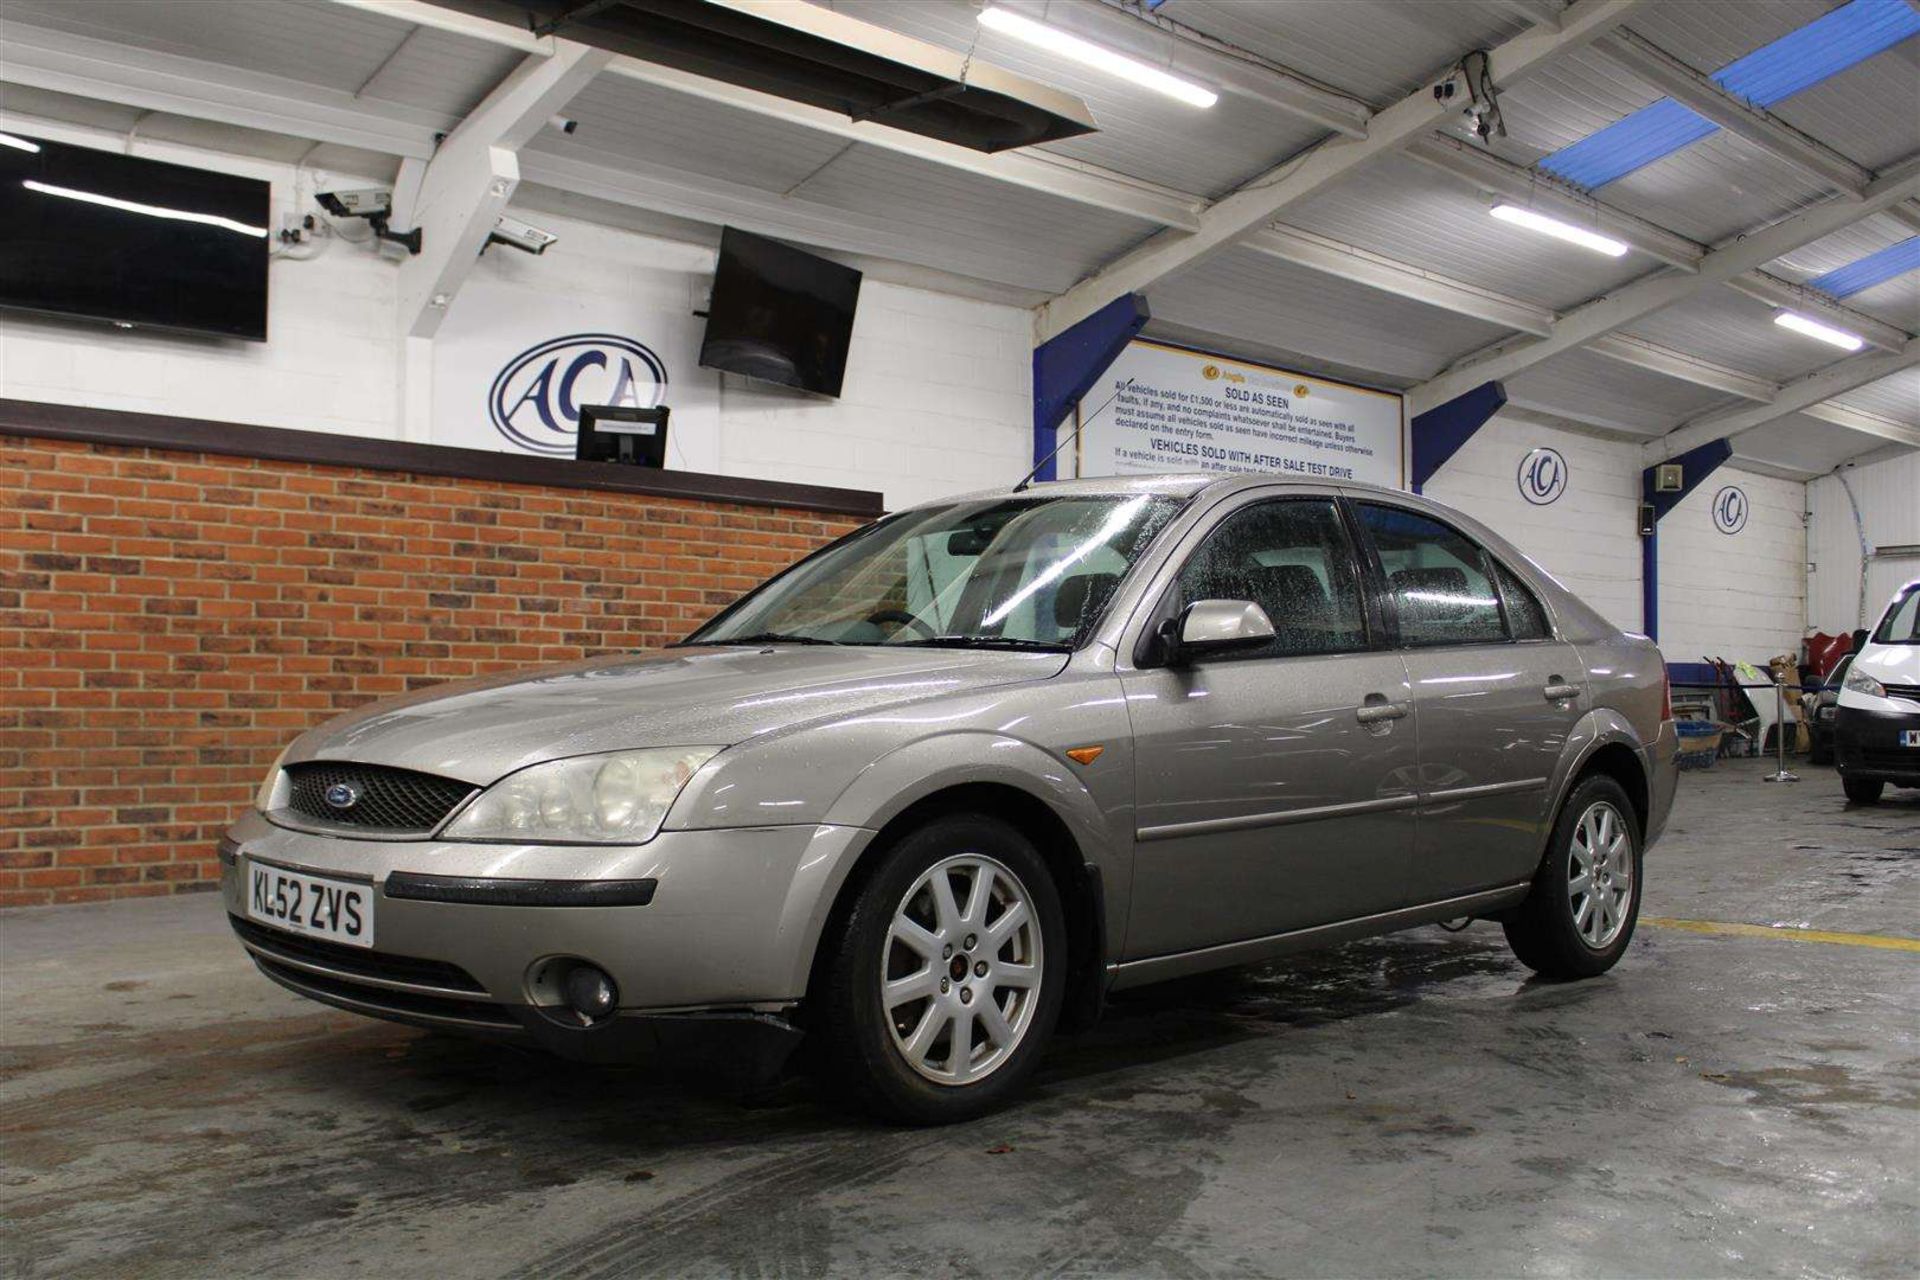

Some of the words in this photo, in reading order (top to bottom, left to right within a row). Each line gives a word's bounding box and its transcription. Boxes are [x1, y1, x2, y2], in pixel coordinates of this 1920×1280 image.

[1115, 381, 1126, 389] All
[1127, 384, 1158, 396] vehicles
[1161, 390, 1176, 399] sold
[1178, 392, 1188, 401] for
[1223, 401, 1237, 411] less
[1251, 408, 1293, 422] automatically
[1295, 415, 1308, 424] sold
[1319, 420, 1332, 428] seen
[1334, 423, 1346, 431] with
[1225, 387, 1249, 401] SOLD
[1252, 393, 1264, 404] AS
[1266, 395, 1289, 409] SEEN
[1115, 417, 1148, 430] declared
[1150, 423, 1159, 431] on
[1161, 424, 1173, 434] the
[1175, 426, 1194, 439] entry
[1115, 406, 1135, 416] must
[1136, 409, 1165, 421] assume
[1167, 414, 1176, 422] all
[1178, 416, 1207, 428] vehicles
[1209, 421, 1224, 431] sold
[1235, 426, 1251, 435] seen
[1252, 428, 1268, 438] have
[1269, 430, 1298, 442] incorrect
[1299, 437, 1323, 449] mileage
[1324, 441, 1343, 451] unless
[1150, 400, 1165, 411] any,
[1167, 403, 1180, 412] and
[1182, 406, 1191, 414] no
[1193, 408, 1231, 420] complaints
[1233, 415, 1270, 427] whatsoever
[1271, 421, 1287, 430] shall
[1288, 424, 1296, 432] be
[1335, 431, 1355, 443] Buyers
[1129, 451, 1156, 461] vehicle
[1158, 454, 1164, 462] is
[1166, 455, 1182, 464] sold
[1201, 461, 1209, 469] an
[1211, 462, 1227, 471] after
[1228, 464, 1242, 472] sale
[1150, 438, 1199, 456] VEHICLES
[1201, 445, 1226, 460] SOLD
[1228, 449, 1251, 464] WITH
[1253, 454, 1281, 468] AFTER
[1283, 458, 1305, 472] SALE
[1307, 462, 1327, 475] TEST
[1329, 466, 1353, 480] DRIVE
[1522, 455, 1560, 497] ACA
[1716, 492, 1743, 527] ACA
[254, 870, 302, 923] KL52
[310, 884, 362, 936] ZVS
